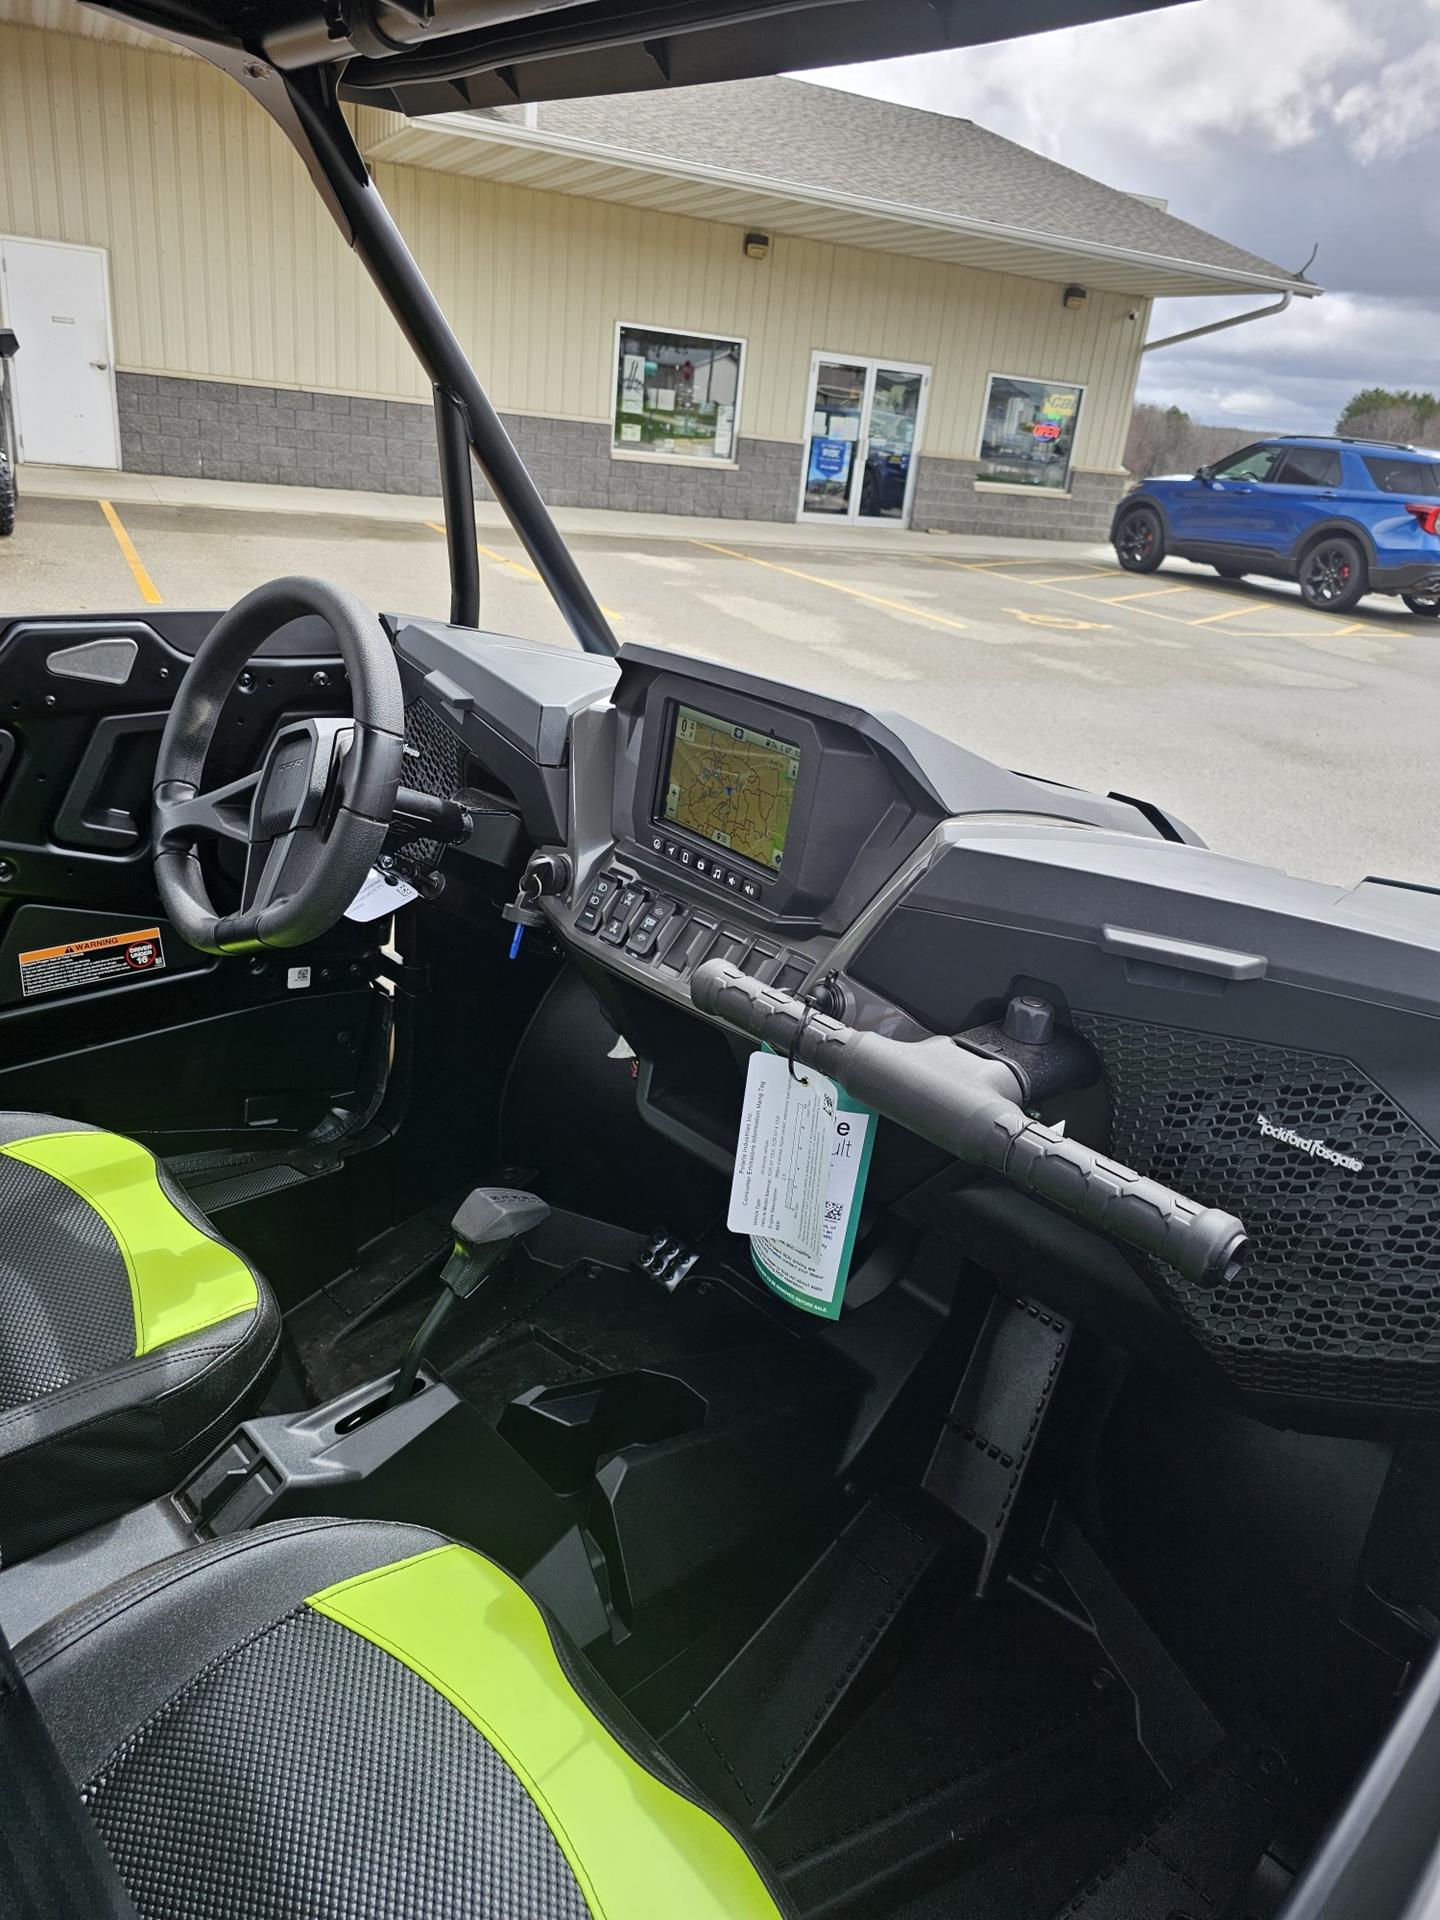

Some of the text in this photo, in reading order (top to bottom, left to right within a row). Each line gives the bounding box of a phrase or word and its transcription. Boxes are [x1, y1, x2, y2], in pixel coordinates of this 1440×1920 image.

[75, 937, 118, 951] WARNING
[129, 944, 152, 953] DRIVER
[130, 950, 152, 958] UNDER
[136, 956, 148, 964] 16
[741, 1122, 751, 1152] Industries
[750, 1110, 760, 1143] Information
[746, 1144, 756, 1174] Emissions
[742, 1176, 751, 1206] Consumer
